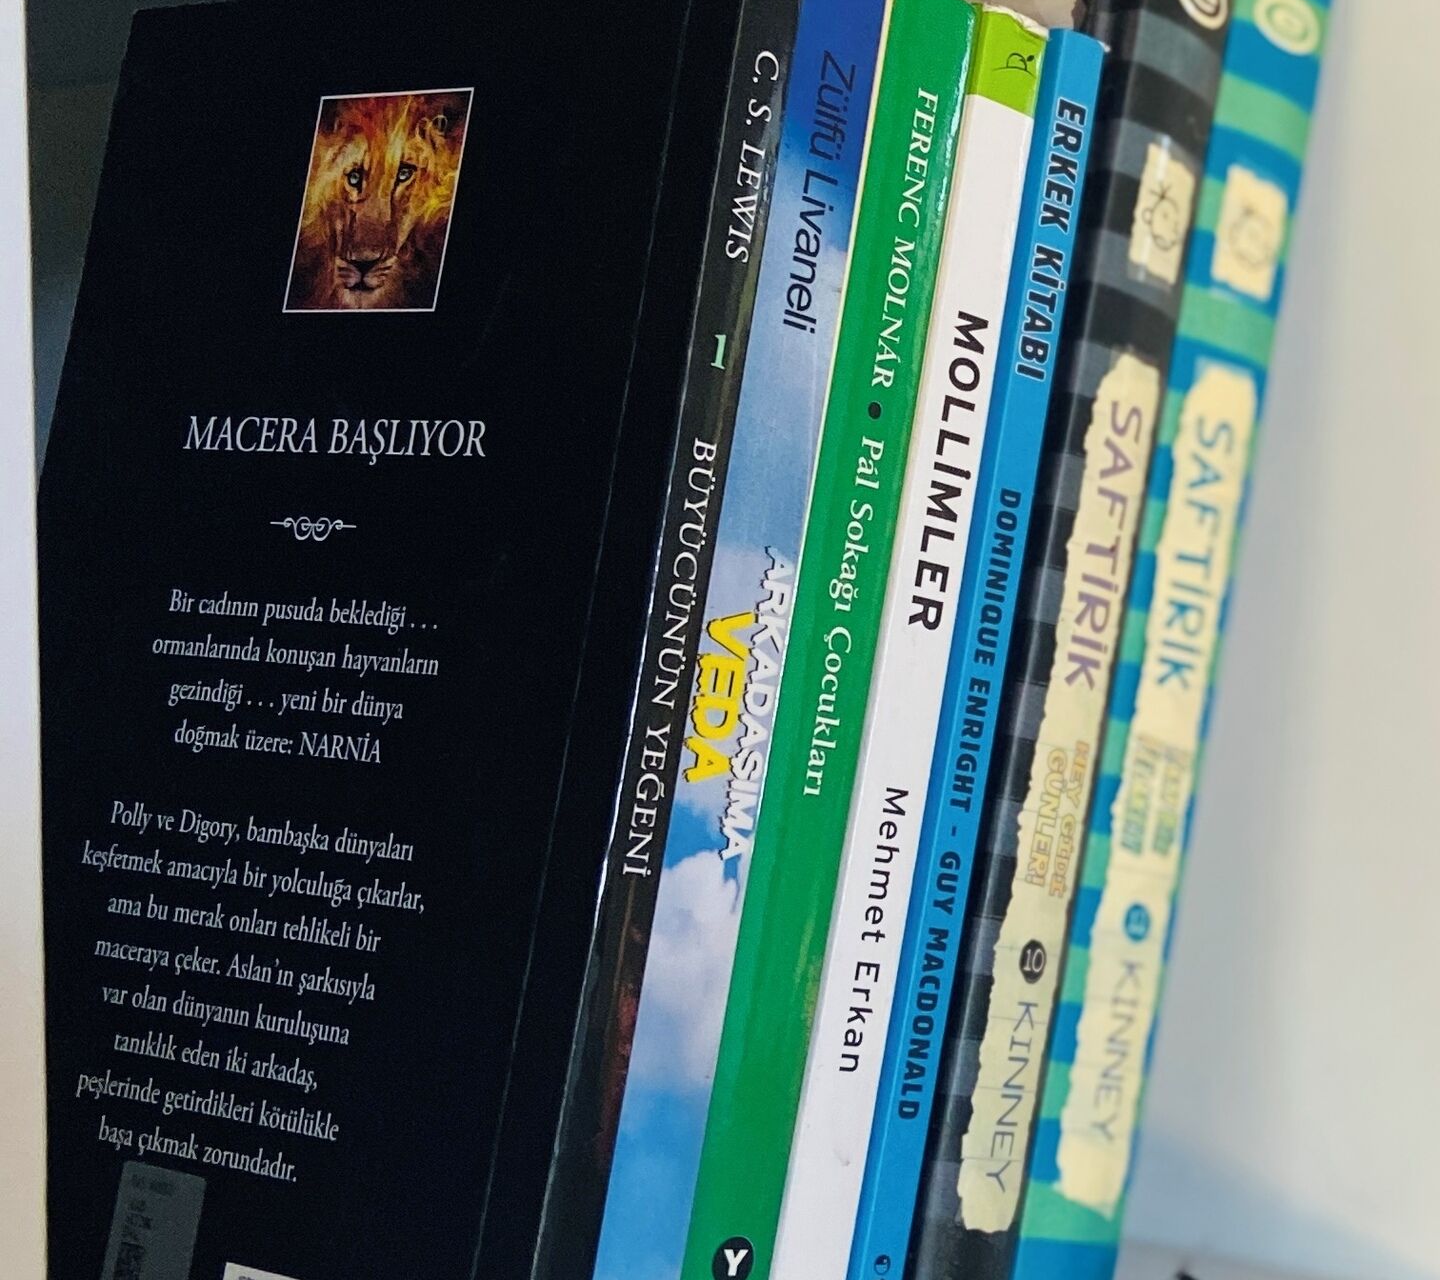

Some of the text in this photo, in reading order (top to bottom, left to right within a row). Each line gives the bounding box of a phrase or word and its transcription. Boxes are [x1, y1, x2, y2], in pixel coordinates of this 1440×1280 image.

[725, 50, 780, 264] C. S. LEWIS
[783, 50, 857, 335] Zülfü Livaneli
[871, 87, 938, 388] FERENC MOLNÁR
[1016, 96, 1087, 383] ERKEK KİTABI
[710, 334, 727, 370] 1
[183, 416, 486, 466] MACERA BAŞLIYOR
[907, 310, 989, 631] MOLLİMLER
[974, 488, 1021, 667] DOMINIQUE
[1064, 400, 1142, 691] SAFTİRİK
[169, 589, 195, 613] Bir
[199, 591, 258, 618] cadının
[262, 597, 323, 626] pusuda
[329, 598, 406, 635] beklediği
[803, 435, 884, 798] Pál Sokağı Çocukları
[152, 634, 439, 677] ormanlarında konuşan hayvanların
[622, 437, 717, 878] BÜYÜCÜNÜN YEĞENİ
[168, 679, 243, 712] gezindiği
[278, 691, 317, 716] yeni
[322, 688, 347, 713] bir
[352, 691, 403, 726] dünya
[682, 611, 758, 784] VEDA
[174, 719, 381, 764] doğmak üzere: NARNİA
[950, 679, 991, 813] ENRIGHT
[1066, 740, 1090, 808] HEY
[110, 800, 413, 864] Polly ve Digory, bambaşka dünyaları
[1024, 747, 1068, 887] GÜNLER!
[81, 840, 425, 914] keşfetmek amacıyla bir yolculuğa çıkarlar,
[931, 851, 961, 916] GUY
[107, 893, 382, 953] ama bu merak onları tehlikeli bir
[839, 787, 909, 1073] Mehmet Erkan
[94, 939, 169, 972] maceraya
[175, 946, 220, 976] çeker.
[296, 966, 375, 1005] şarkısıyla
[1022, 948, 1045, 973] 10
[102, 985, 350, 1046] var olan dünyanın kuruluşuna
[898, 927, 949, 1120] MACDONALD
[1092, 959, 1143, 1142] KINNEY
[114, 1031, 317, 1093] tanıklık eden iki arkadaş,
[986, 1001, 1038, 1193] KINNEY
[75, 1070, 340, 1142] peşlerinde getirdikleri kötülükle
[99, 1115, 297, 1182] başa çıkmak zorundadır.
